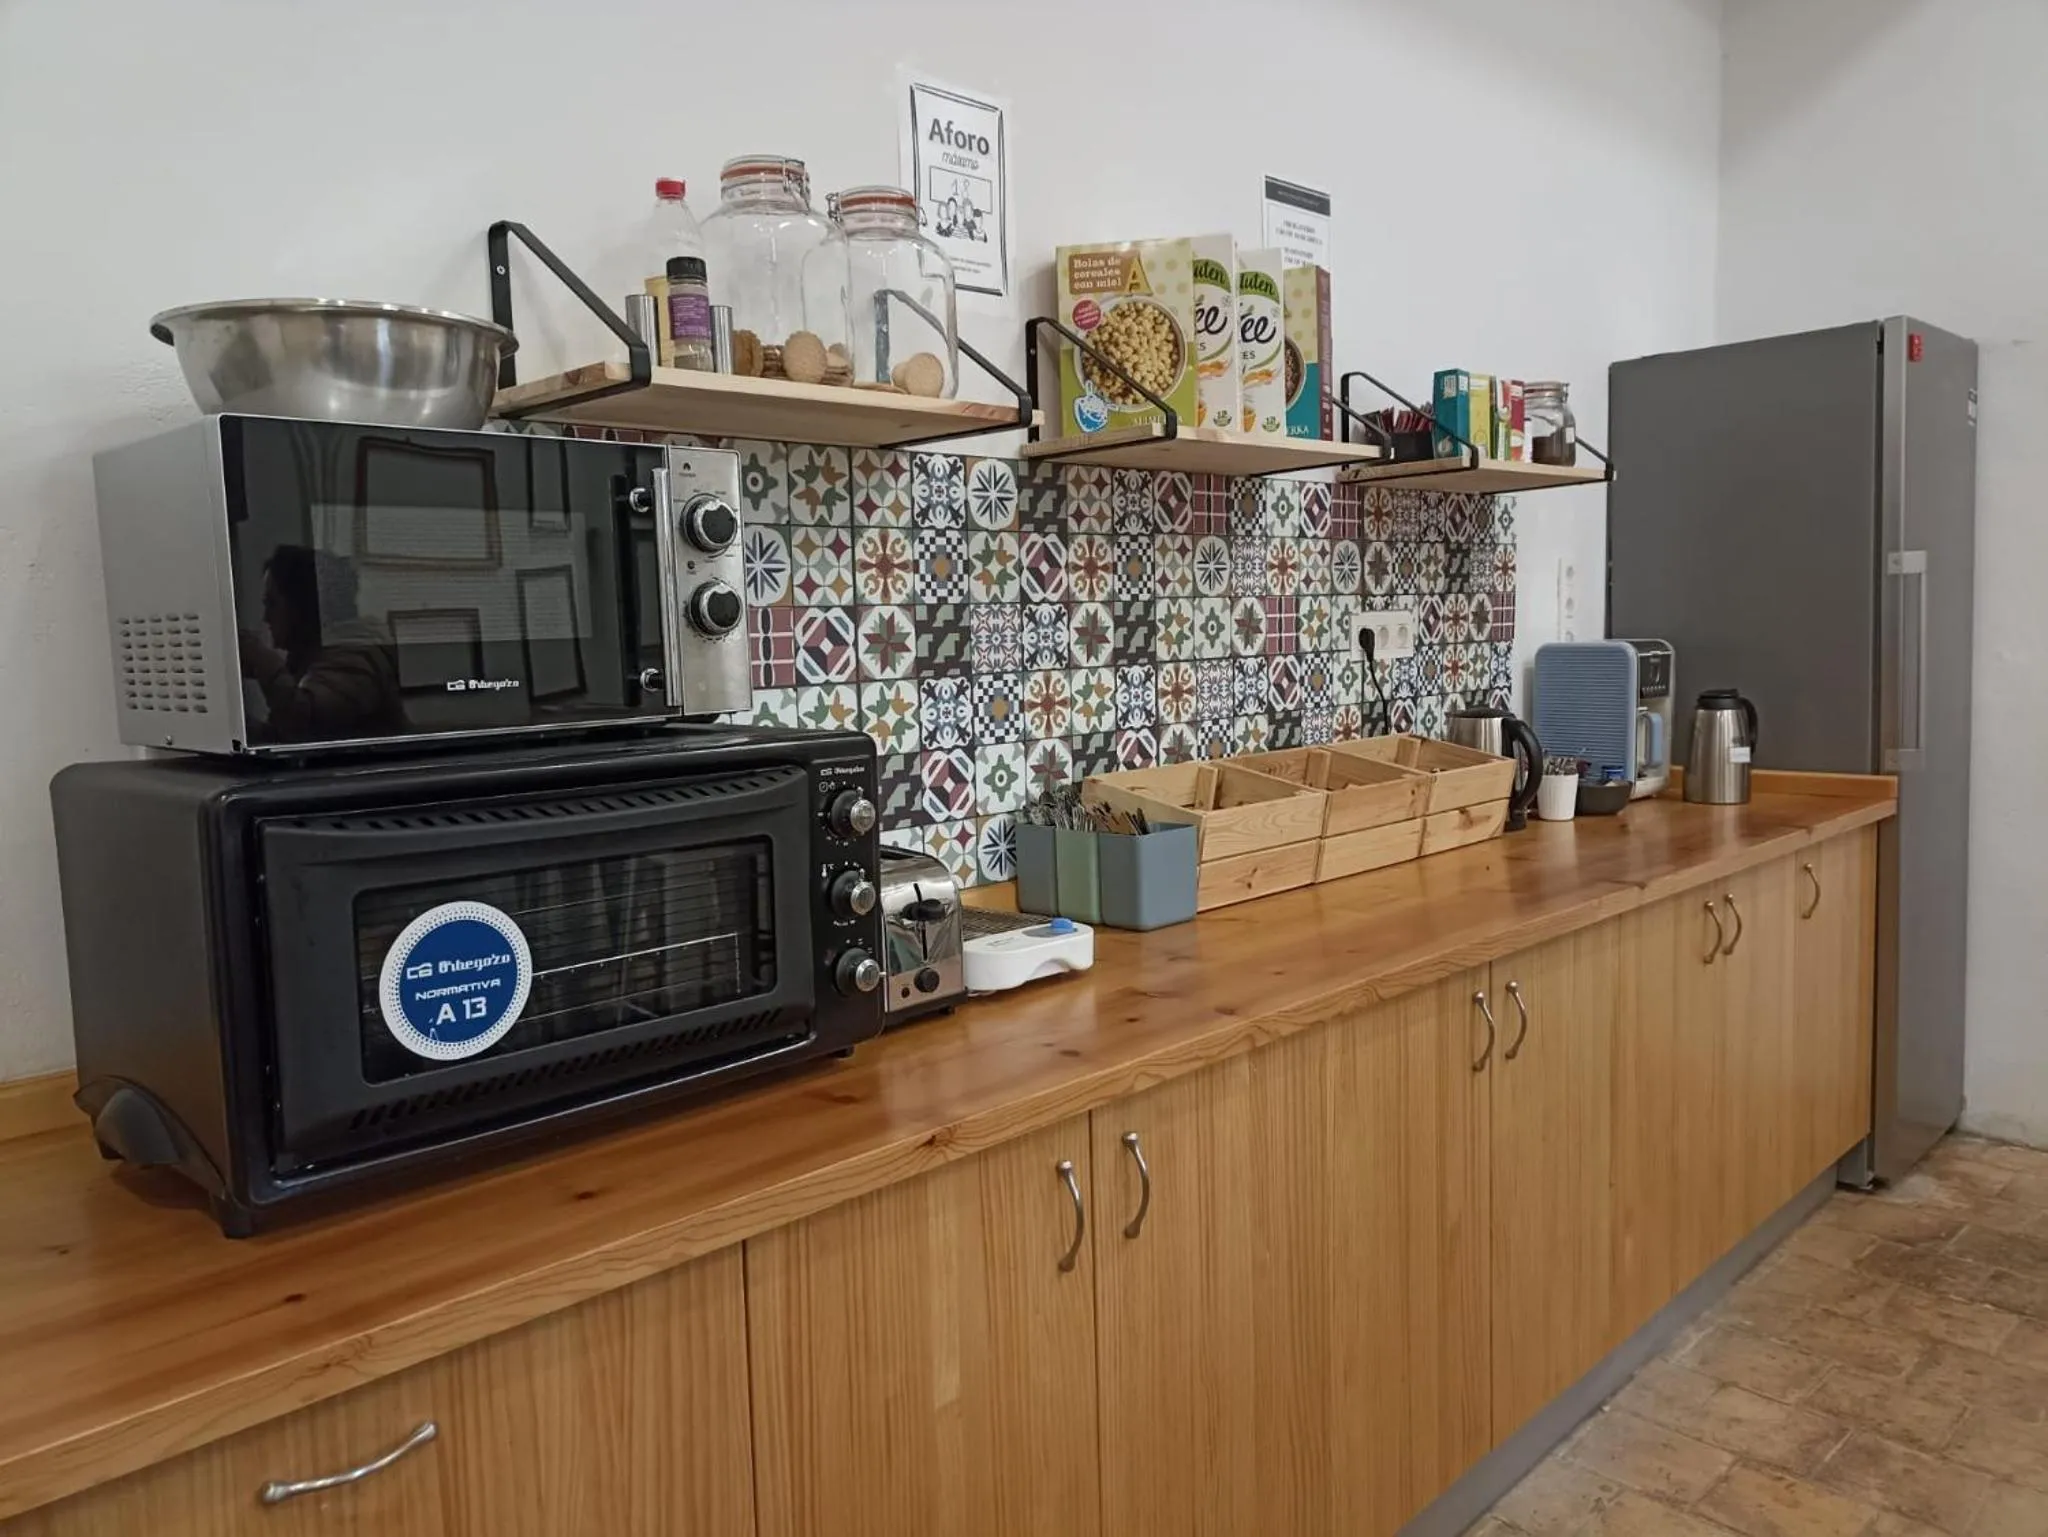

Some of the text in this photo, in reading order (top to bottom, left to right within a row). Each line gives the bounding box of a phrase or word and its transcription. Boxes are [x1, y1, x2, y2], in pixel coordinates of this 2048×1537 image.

[929, 118, 989, 155] Aforo
[1073, 256, 1121, 269] Bolas de
[1073, 267, 1121, 279] cereales
[1193, 261, 1226, 285] uten
[1073, 277, 1121, 289] con miel
[1239, 273, 1275, 295] luten
[1241, 350, 1256, 360] ES
[438, 953, 510, 974] Orbegozo
[415, 978, 501, 1001] NORMATIVA
[436, 996, 487, 1025] A 13
